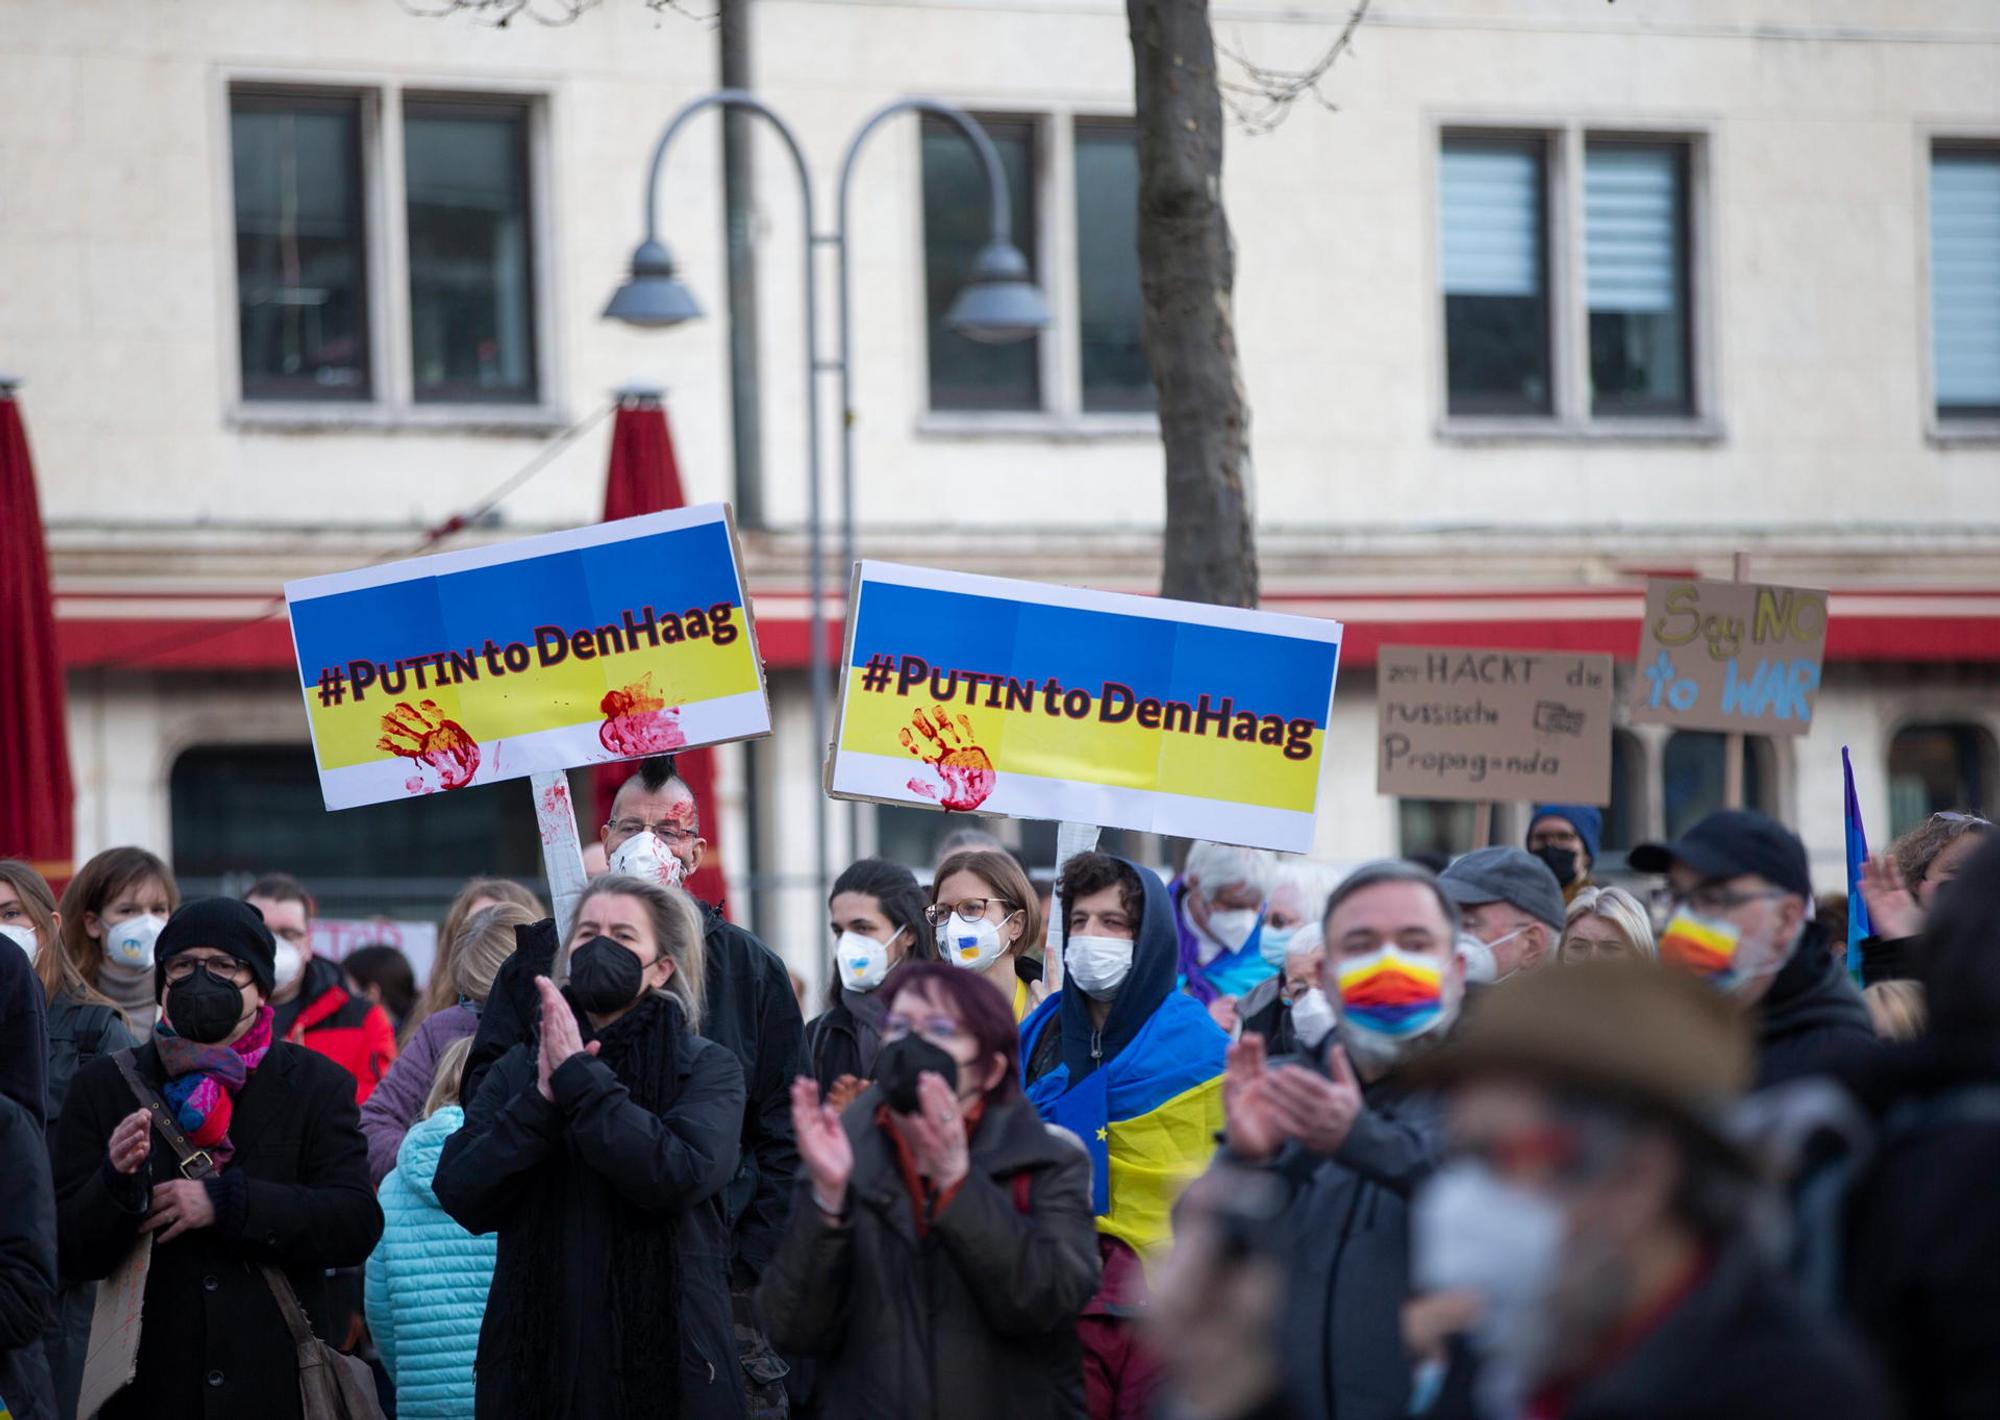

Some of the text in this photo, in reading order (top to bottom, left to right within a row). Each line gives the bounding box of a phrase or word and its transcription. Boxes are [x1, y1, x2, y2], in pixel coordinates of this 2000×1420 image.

[1653, 583, 1826, 661] Say NO
[1566, 660, 1601, 689] die
[1643, 648, 1821, 722] to WAR
[1387, 699, 1498, 725] russische
